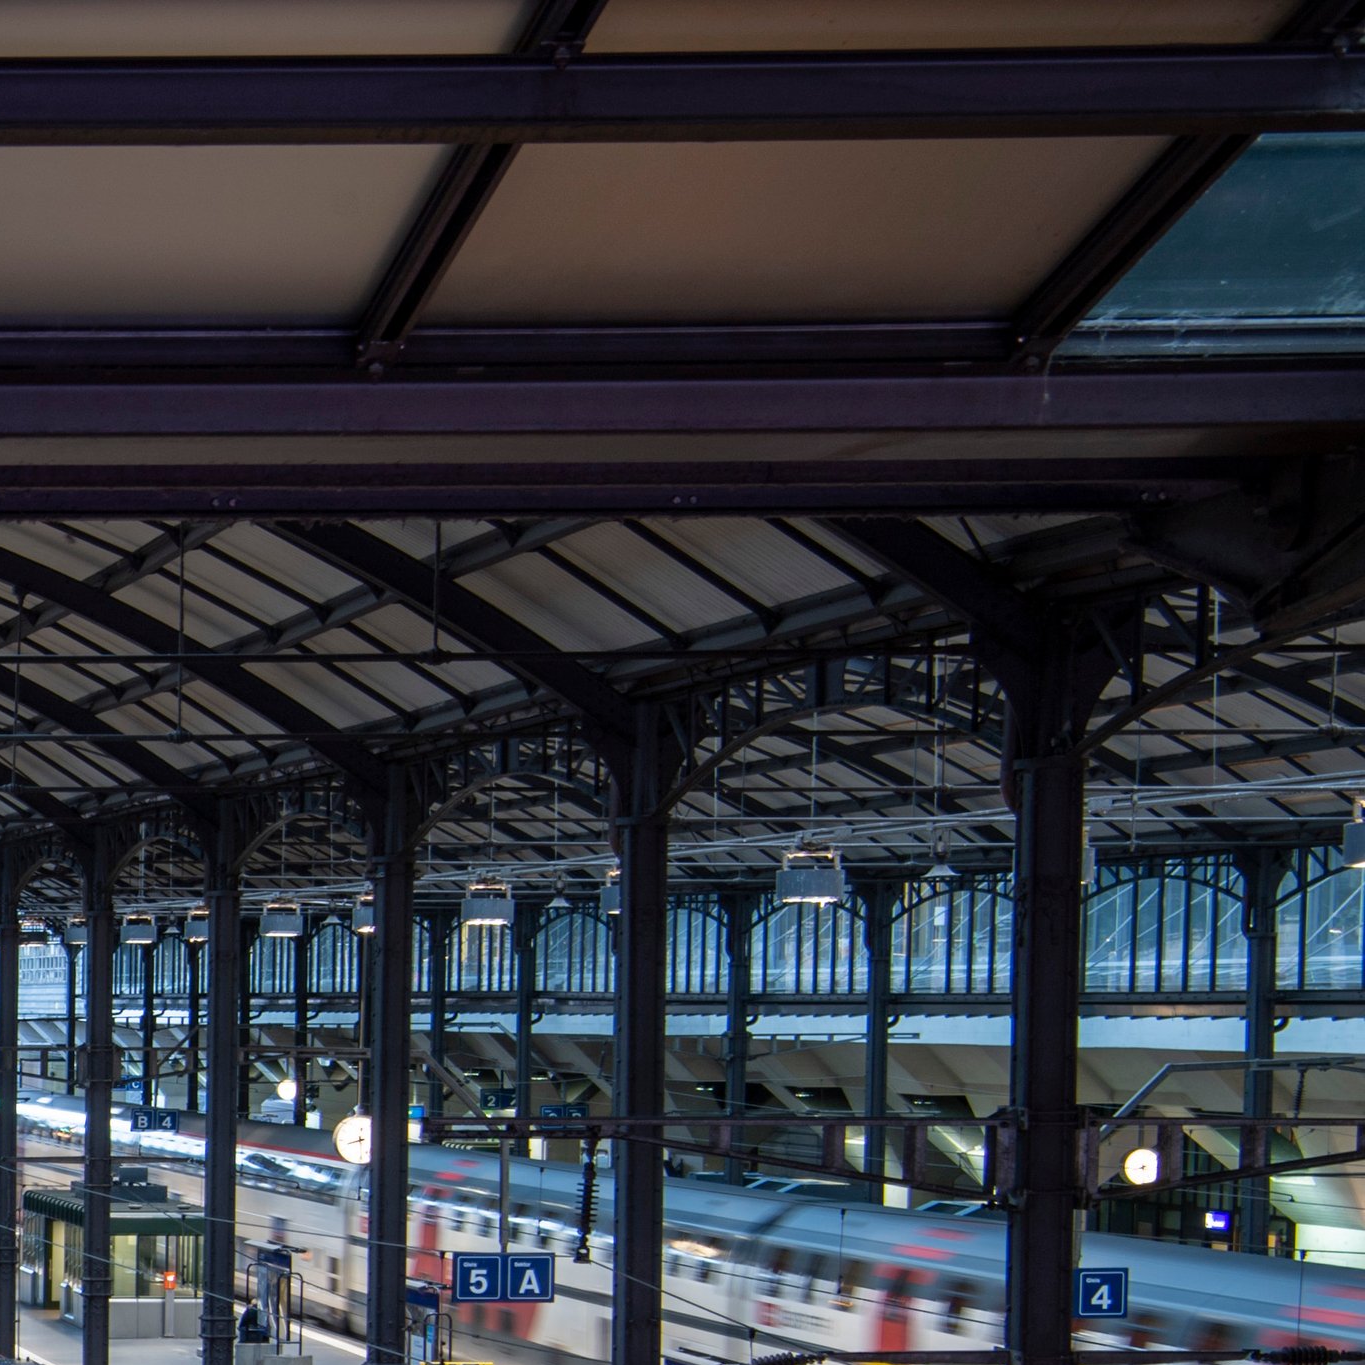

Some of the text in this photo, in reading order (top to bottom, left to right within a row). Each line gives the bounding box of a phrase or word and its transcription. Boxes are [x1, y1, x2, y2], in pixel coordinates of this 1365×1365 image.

[487, 1096, 496, 1106] 2
[137, 1116, 172, 1128] B 4
[469, 1270, 540, 1294] 5 A
[1091, 1285, 1111, 1310] 4
